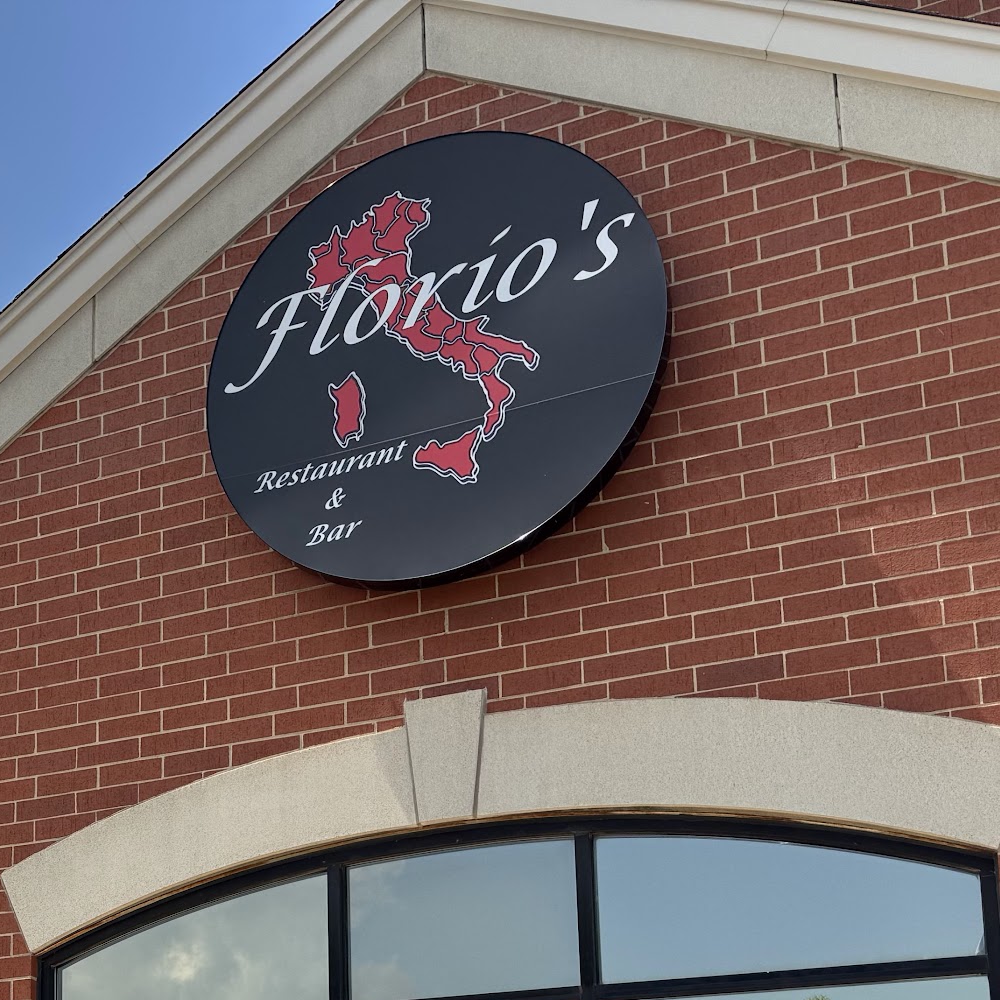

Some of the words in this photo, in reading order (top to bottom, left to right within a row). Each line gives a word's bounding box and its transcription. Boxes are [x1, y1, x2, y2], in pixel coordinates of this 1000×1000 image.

[224, 198, 636, 395] Florio's
[253, 439, 409, 495] Restaurant
[324, 487, 347, 510] &
[305, 519, 363, 548] Bar
